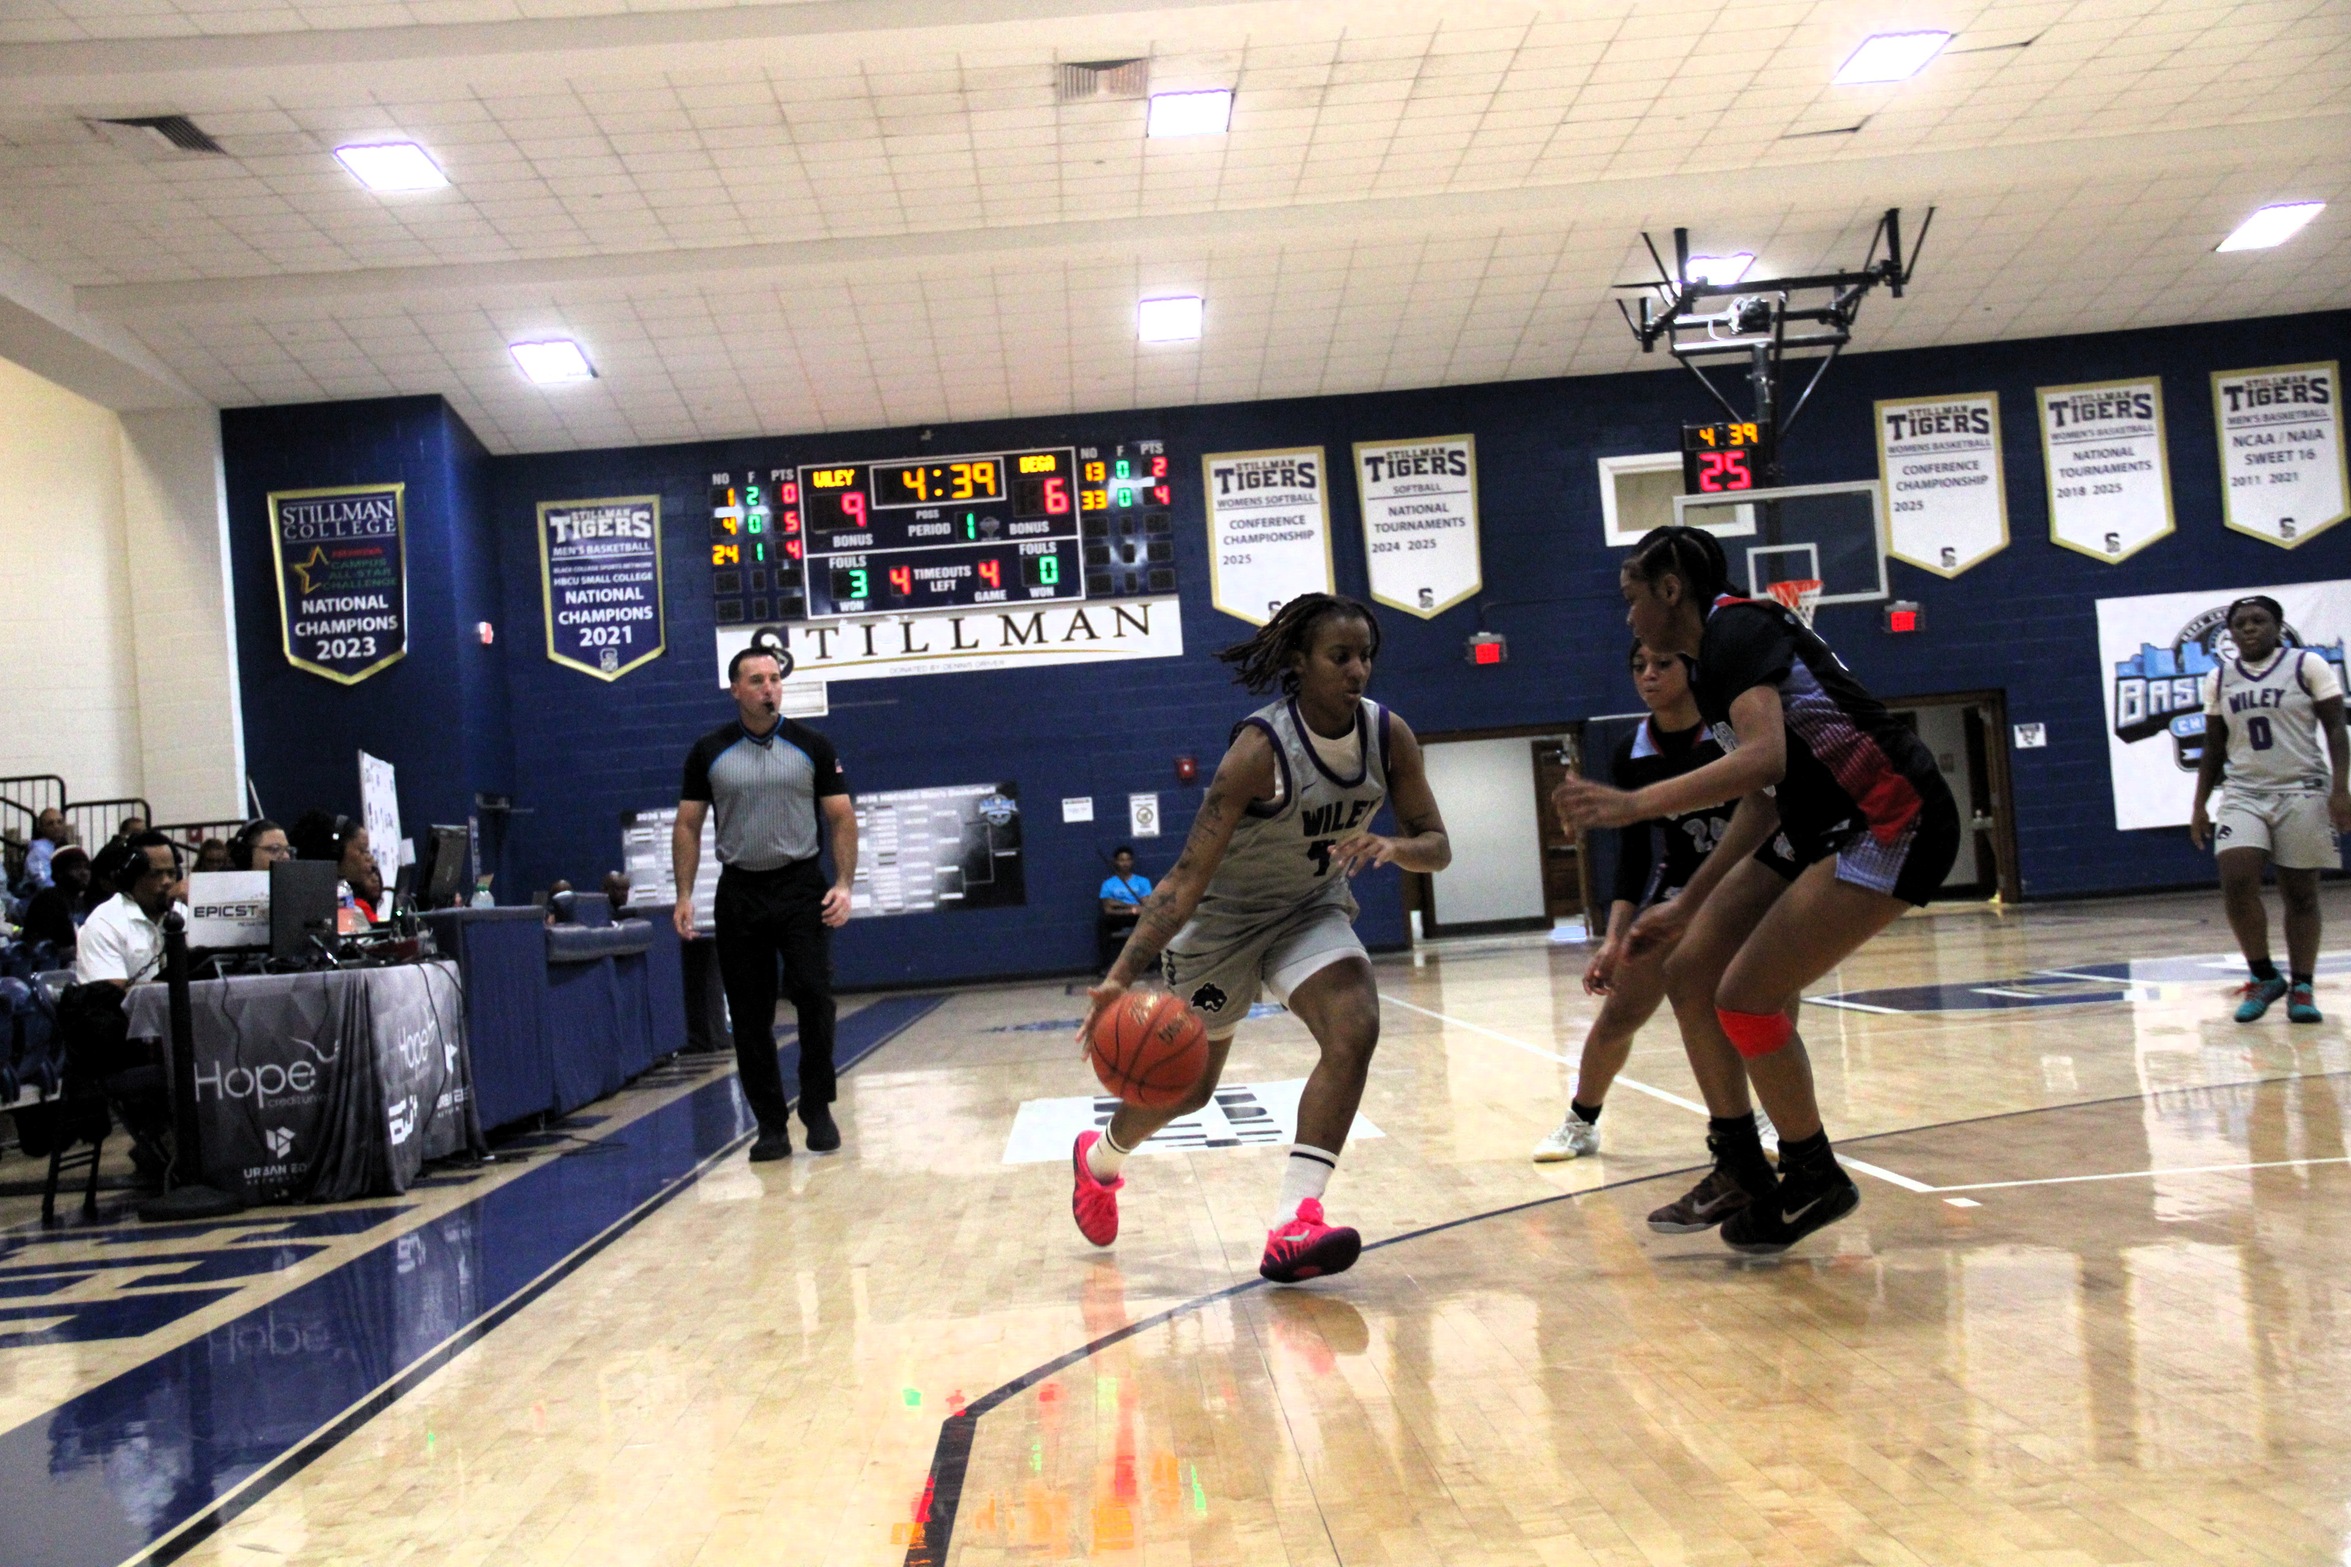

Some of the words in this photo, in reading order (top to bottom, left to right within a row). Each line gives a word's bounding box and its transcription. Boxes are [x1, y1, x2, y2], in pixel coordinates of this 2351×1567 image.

[2244, 375, 2307, 388] STILLMAN
[2069, 391, 2131, 403] STILLMAN
[2223, 377, 2329, 411] TIGERS
[1908, 405, 1968, 417] STILLMAN
[2048, 393, 2152, 427] TIGERS
[2263, 409, 2328, 422] BASKETBALL
[1887, 408, 1989, 440] TIGERS
[2097, 425, 2154, 436] BASKETBALL
[2233, 433, 2275, 447] NCAA
[2287, 429, 2325, 442] NAIA
[1081, 447, 1098, 459] NO
[1117, 446, 1124, 456] F
[1141, 443, 1164, 455] PTS
[1386, 447, 1446, 459] STILLMAN
[1888, 443, 1930, 454] WOMENS
[1932, 439, 1991, 450] BASKETBALL
[2073, 448, 2135, 461] NATIONAL
[1019, 455, 1056, 473] DEGA
[2245, 450, 2294, 465] SWEET
[2299, 448, 2316, 460] 16
[1085, 461, 1106, 482] 13
[1115, 460, 1130, 479] 0
[1152, 456, 1168, 477] 2
[1236, 459, 1296, 472] STILLMAN
[1365, 450, 1466, 482] TIGERS
[1699, 450, 1751, 492] 25
[1902, 460, 1979, 476] CONFERENCE
[2059, 460, 2153, 478] TOURNAMENTS
[712, 473, 730, 485] NO
[747, 472, 756, 483] F
[771, 469, 795, 481] PTS
[902, 461, 996, 501] 4:39
[1214, 462, 1316, 494] TIGERS
[1896, 475, 1988, 491] CHAMPIONSHIP
[2231, 475, 2261, 486] 2011
[2269, 472, 2299, 483] 2021
[727, 488, 736, 507] 1
[746, 486, 759, 506] 2
[782, 483, 798, 504] 0
[1044, 478, 1069, 514] 6
[1393, 483, 1442, 494] SOFTBALL
[2057, 487, 2086, 498] 2018
[2093, 483, 2122, 495] 2025
[1081, 489, 1108, 511] 33
[1117, 488, 1132, 508] 0
[1154, 485, 1170, 505] 4
[1217, 497, 1263, 508] WOMENS
[1265, 494, 1315, 505] SOFTBALL
[1894, 500, 1924, 512] 2025
[282, 500, 394, 526] STILLMAN
[571, 509, 631, 520] STILLMAN
[841, 492, 867, 527] 9
[916, 510, 940, 519] POSS
[1388, 503, 1449, 516] NATIONAL
[284, 518, 397, 540] COLLEGE
[550, 511, 652, 543] TIGERS
[722, 516, 737, 535] 4
[748, 514, 762, 534] 0
[784, 511, 799, 532] 5
[908, 523, 951, 537] PERIOD
[966, 513, 976, 540] 1
[1009, 521, 1050, 535] BONUS
[1229, 515, 1306, 530] CONFERENCE
[1374, 517, 1466, 533] TOURNAMENTS
[833, 534, 873, 548] BONUS
[1223, 530, 1315, 545] CHAMPIONSHIP
[553, 546, 584, 556] MEN'S
[586, 541, 651, 554] BASKETBALL
[712, 544, 740, 565] 24
[756, 543, 764, 561] 1
[786, 540, 801, 559] 4
[1019, 542, 1057, 555] FOULS
[1372, 541, 1400, 553] 2024
[1408, 539, 1436, 550] 2025
[829, 555, 867, 569] FOULS
[1223, 554, 1251, 565] 2025
[914, 566, 972, 580] TIMEOUTS
[978, 559, 1000, 588] 4
[1039, 556, 1058, 584] 0
[553, 576, 580, 586] HBCU
[581, 574, 611, 585] SMALL
[612, 571, 653, 583] COLLEGE
[849, 570, 868, 598] 3
[889, 566, 911, 595] 4
[930, 579, 957, 592] LEFT
[565, 587, 645, 604] NATIONAL
[974, 590, 1007, 602] GAME
[1029, 586, 1055, 598] WON
[302, 595, 389, 614] NATIONAL
[840, 600, 864, 612] WON
[558, 606, 654, 625] CHAMPIONS
[295, 615, 398, 636] CHAMPIONS
[579, 625, 632, 647] 2021
[750, 602, 1153, 678] STILLMAN
[316, 637, 377, 660] 2023
[2229, 688, 2286, 715] WILEY
[2248, 716, 2273, 751] 0
[399, 1026, 429, 1081] Hope
[194, 1060, 317, 1109] Hope
[243, 1165, 287, 1178] URBAN
